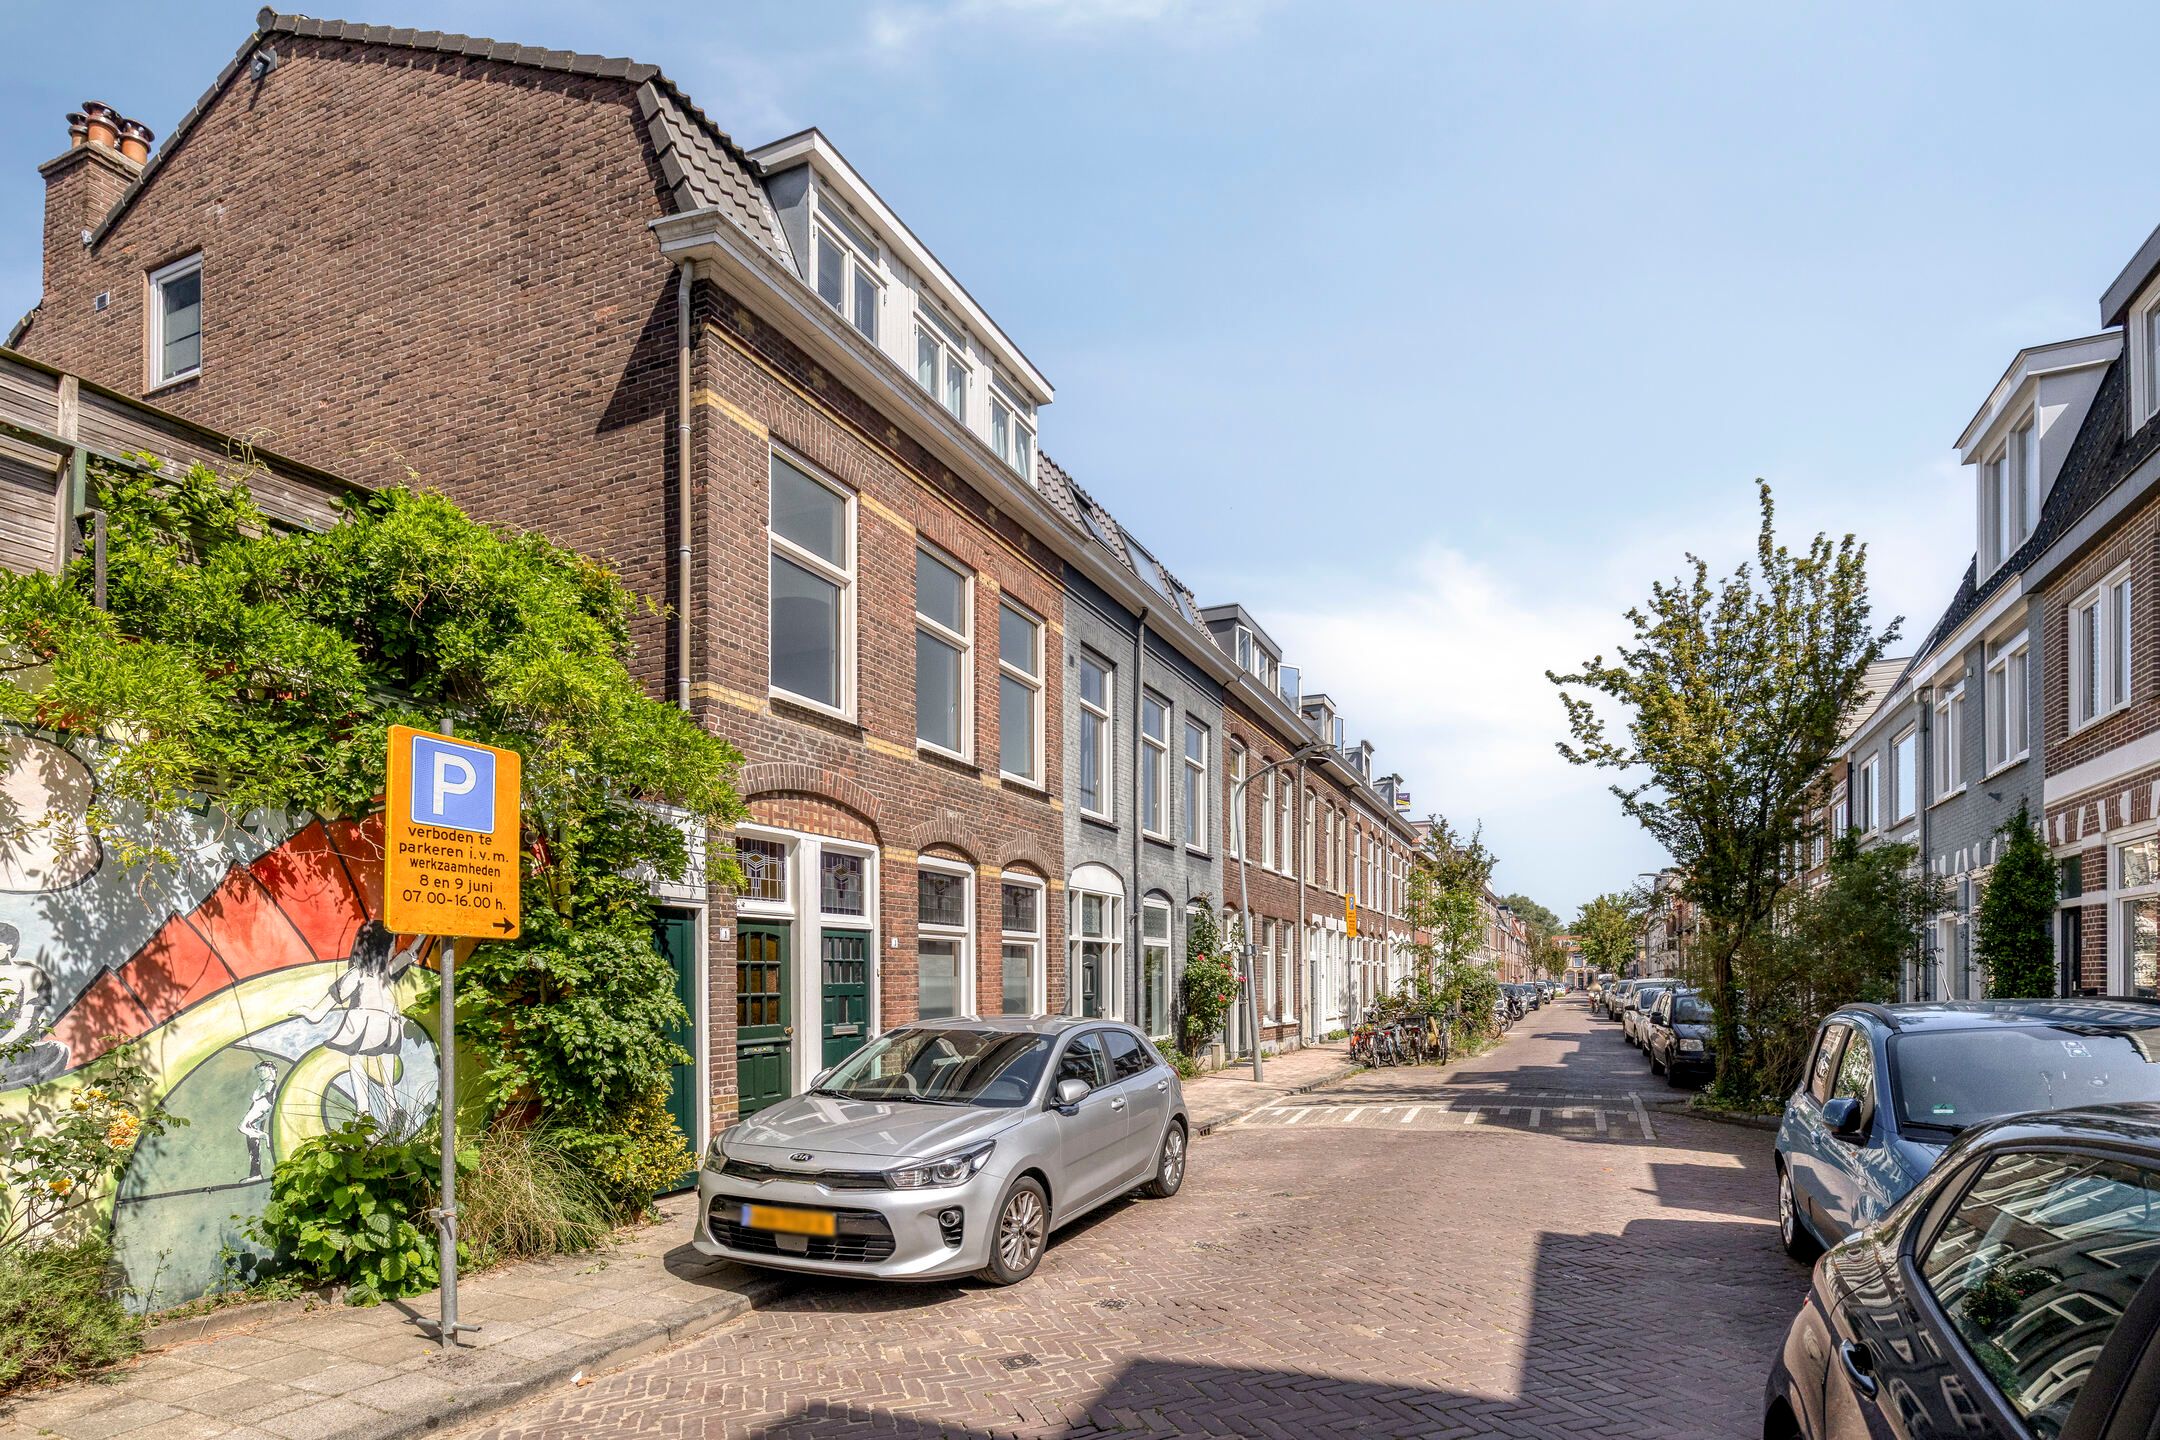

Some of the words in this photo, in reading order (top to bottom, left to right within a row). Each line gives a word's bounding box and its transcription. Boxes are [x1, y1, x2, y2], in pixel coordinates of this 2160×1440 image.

[432, 751, 477, 816] P
[408, 827, 474, 844] verboden
[479, 833, 493, 846] te
[399, 842, 464, 858] parkeren
[469, 846, 509, 863] i.v.m.
[410, 858, 501, 878] werkzaamheden
[419, 874, 429, 887] 8
[434, 878, 450, 889] en
[455, 878, 464, 890] 9
[468, 880, 493, 894] juni
[402, 889, 491, 909] 07.00-16.00
[495, 898, 507, 911] h.
